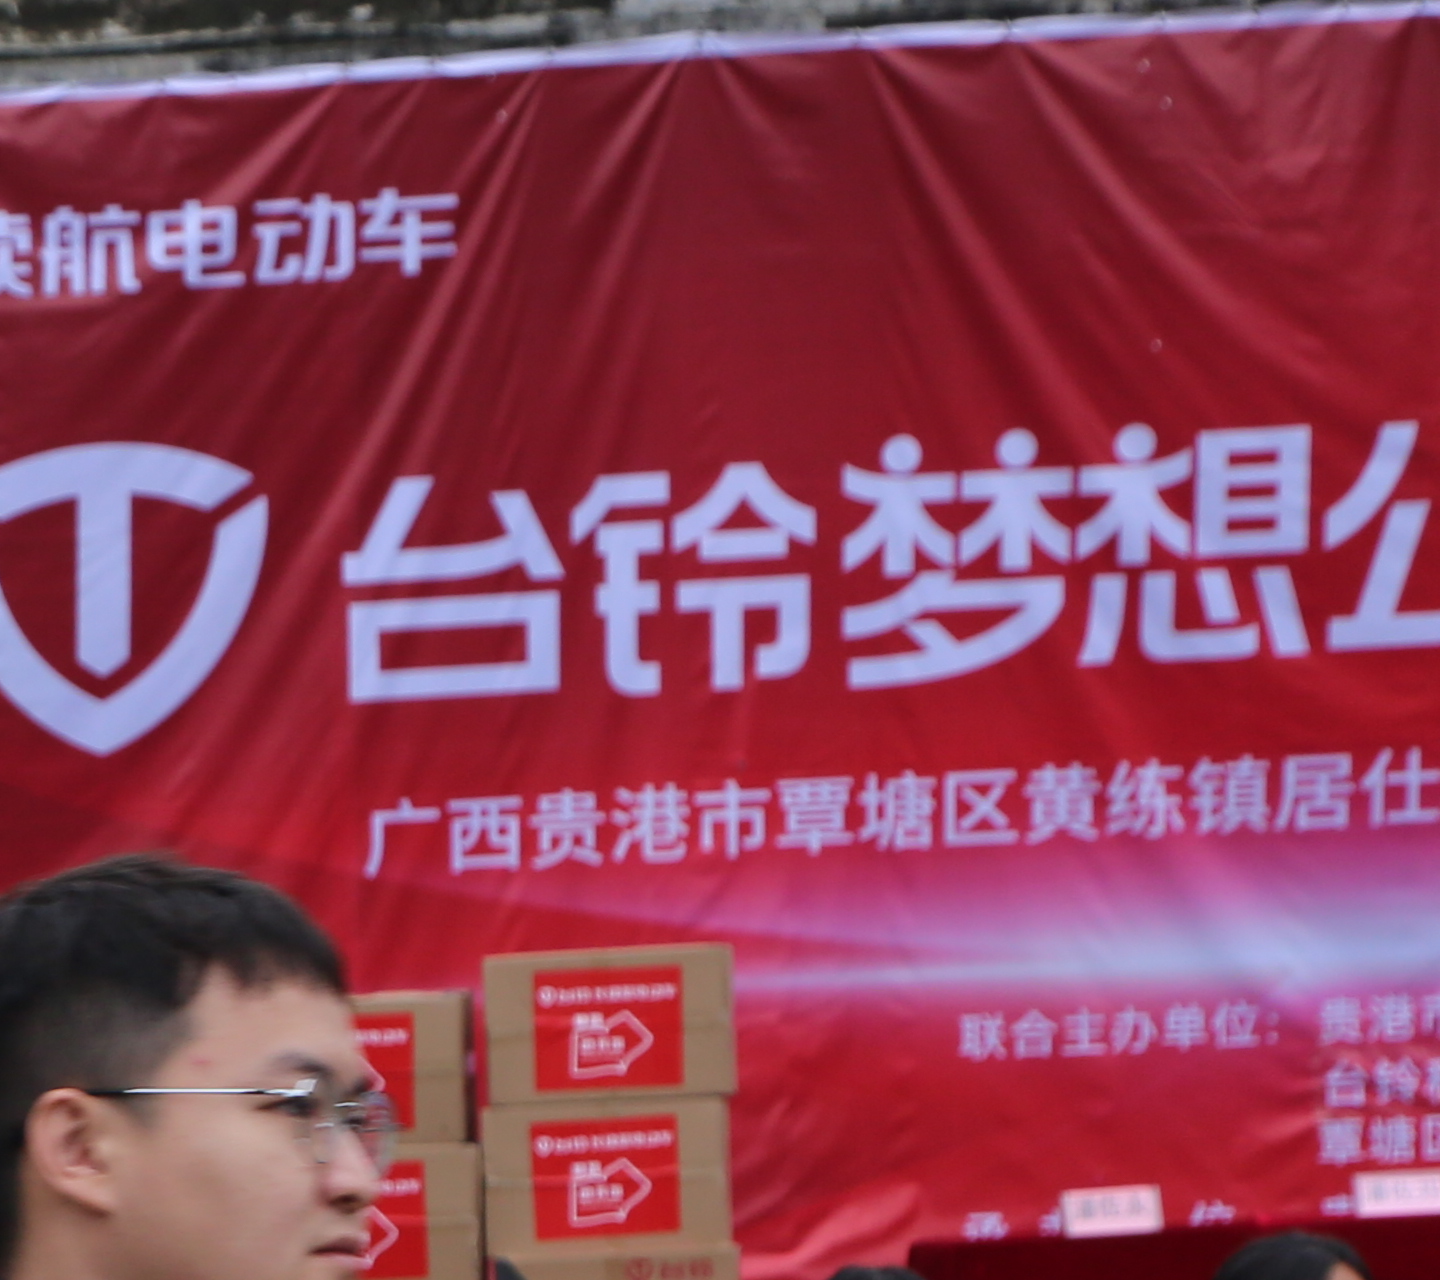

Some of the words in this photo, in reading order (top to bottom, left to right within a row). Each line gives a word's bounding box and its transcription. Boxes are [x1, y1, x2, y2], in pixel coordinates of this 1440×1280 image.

[362, 744, 1440, 880] 广西贵港市覃塘区黄练镇居仕
